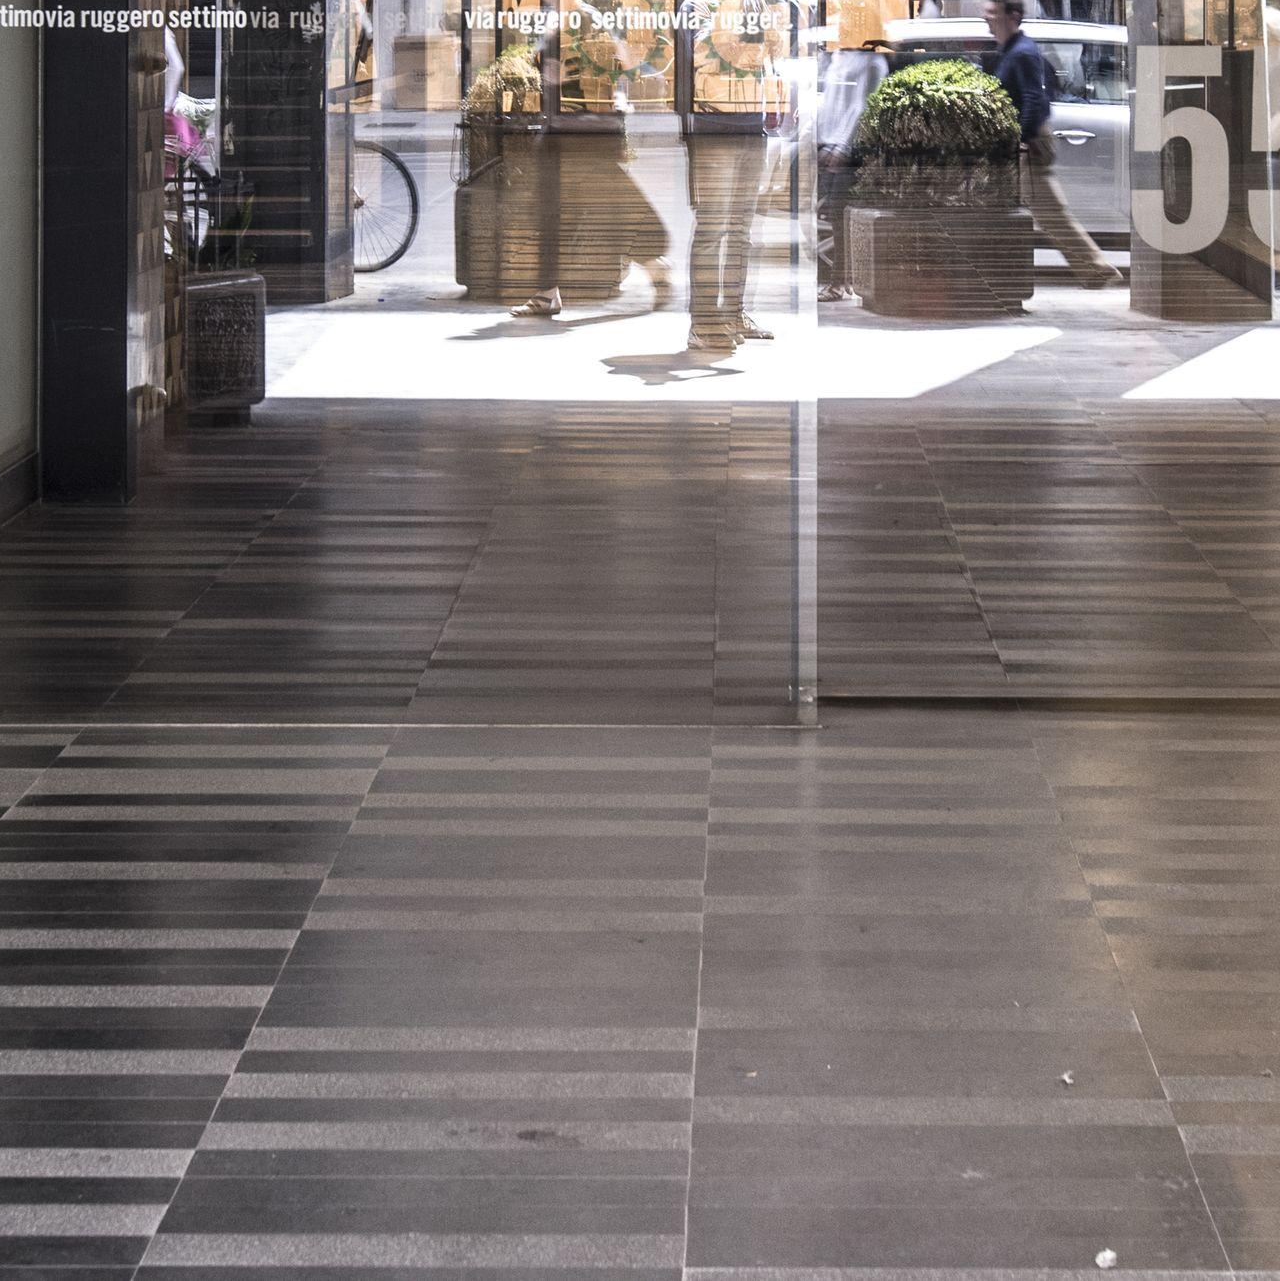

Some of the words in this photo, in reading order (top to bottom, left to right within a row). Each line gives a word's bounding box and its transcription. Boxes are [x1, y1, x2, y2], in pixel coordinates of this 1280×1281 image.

[81, 8, 164, 33] ruggero
[169, 5, 247, 29] settimo
[250, 6, 279, 29] via
[464, 6, 494, 30] via
[498, 9, 581, 34] ruggero
